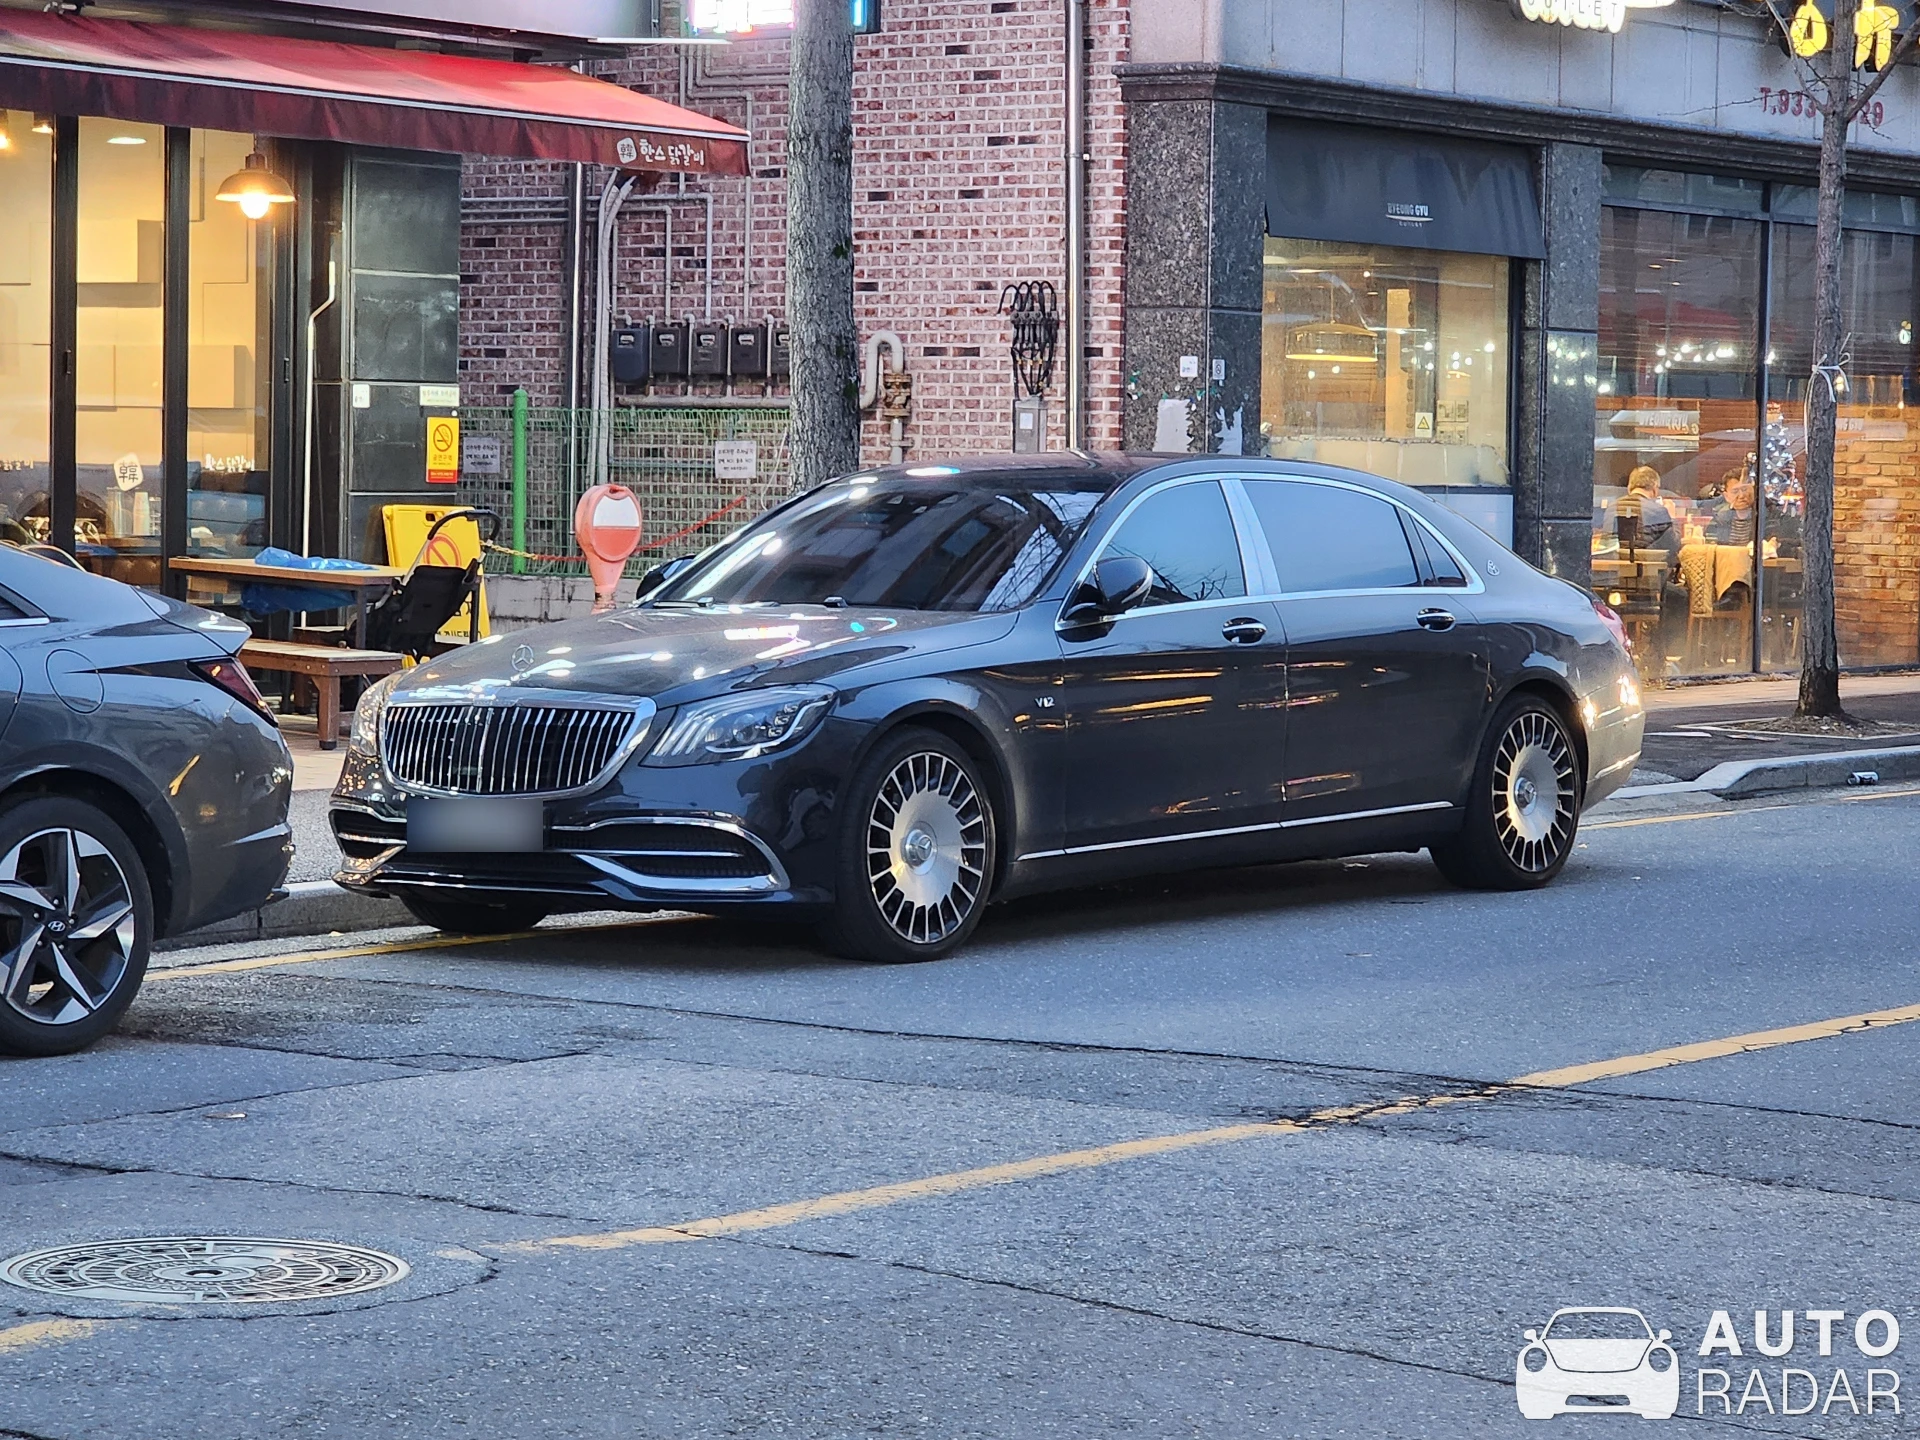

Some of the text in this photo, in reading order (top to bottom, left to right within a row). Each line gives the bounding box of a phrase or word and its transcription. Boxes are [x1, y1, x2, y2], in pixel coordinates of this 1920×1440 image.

[667, 143, 705, 166] 닭갈비
[118, 462, 139, 483] 韓
[1034, 696, 1055, 707] V12
